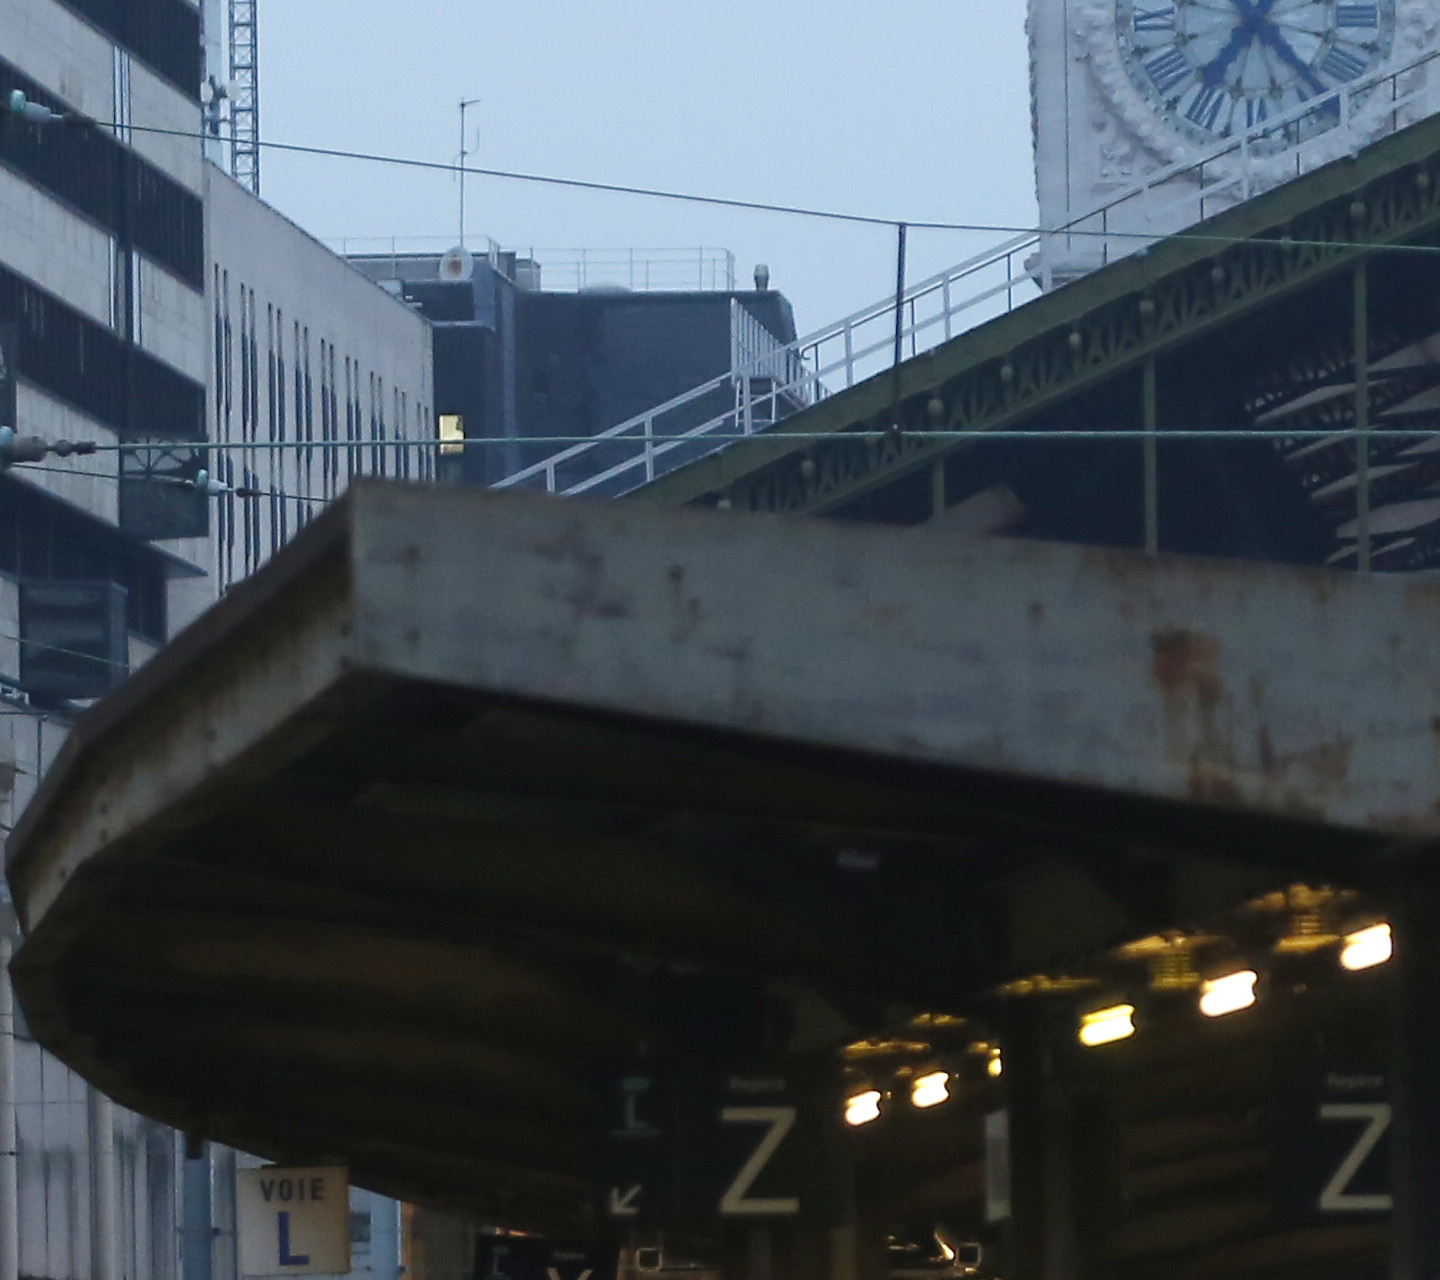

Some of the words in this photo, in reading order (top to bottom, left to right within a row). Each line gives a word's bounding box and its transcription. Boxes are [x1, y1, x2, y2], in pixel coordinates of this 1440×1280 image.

[261, 1178, 325, 1201] VOIE
[719, 1106, 800, 1214] Z
[1318, 1103, 1393, 1209] Z
[278, 1211, 310, 1266] L
